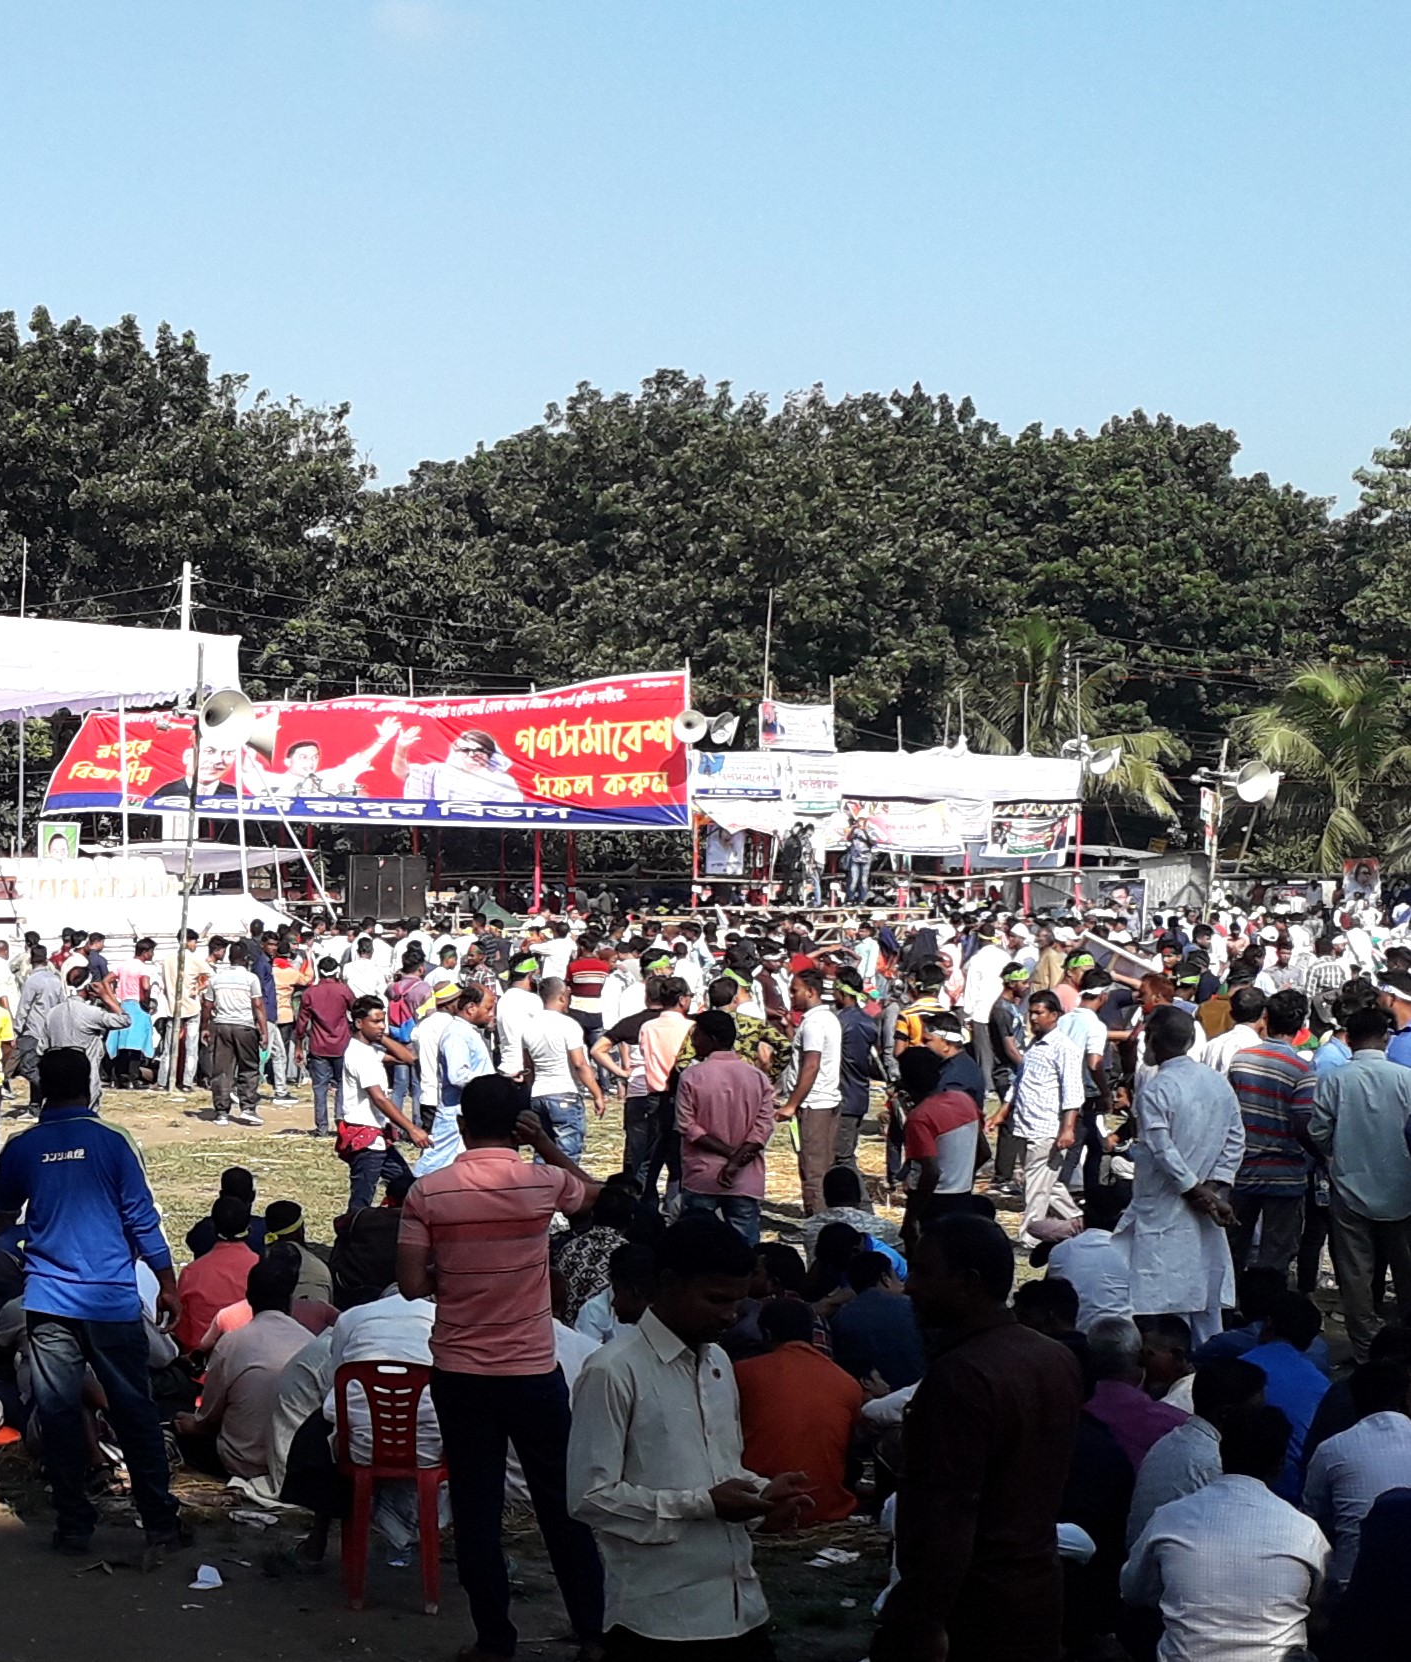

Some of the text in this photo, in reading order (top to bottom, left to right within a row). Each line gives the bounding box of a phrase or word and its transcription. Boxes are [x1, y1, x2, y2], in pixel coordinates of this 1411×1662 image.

[515, 717, 674, 762] গণসমাবেশ
[532, 772, 669, 798] সফল করুন
[304, 801, 426, 818] রংপুর
[437, 801, 571, 819] বিভাগ
